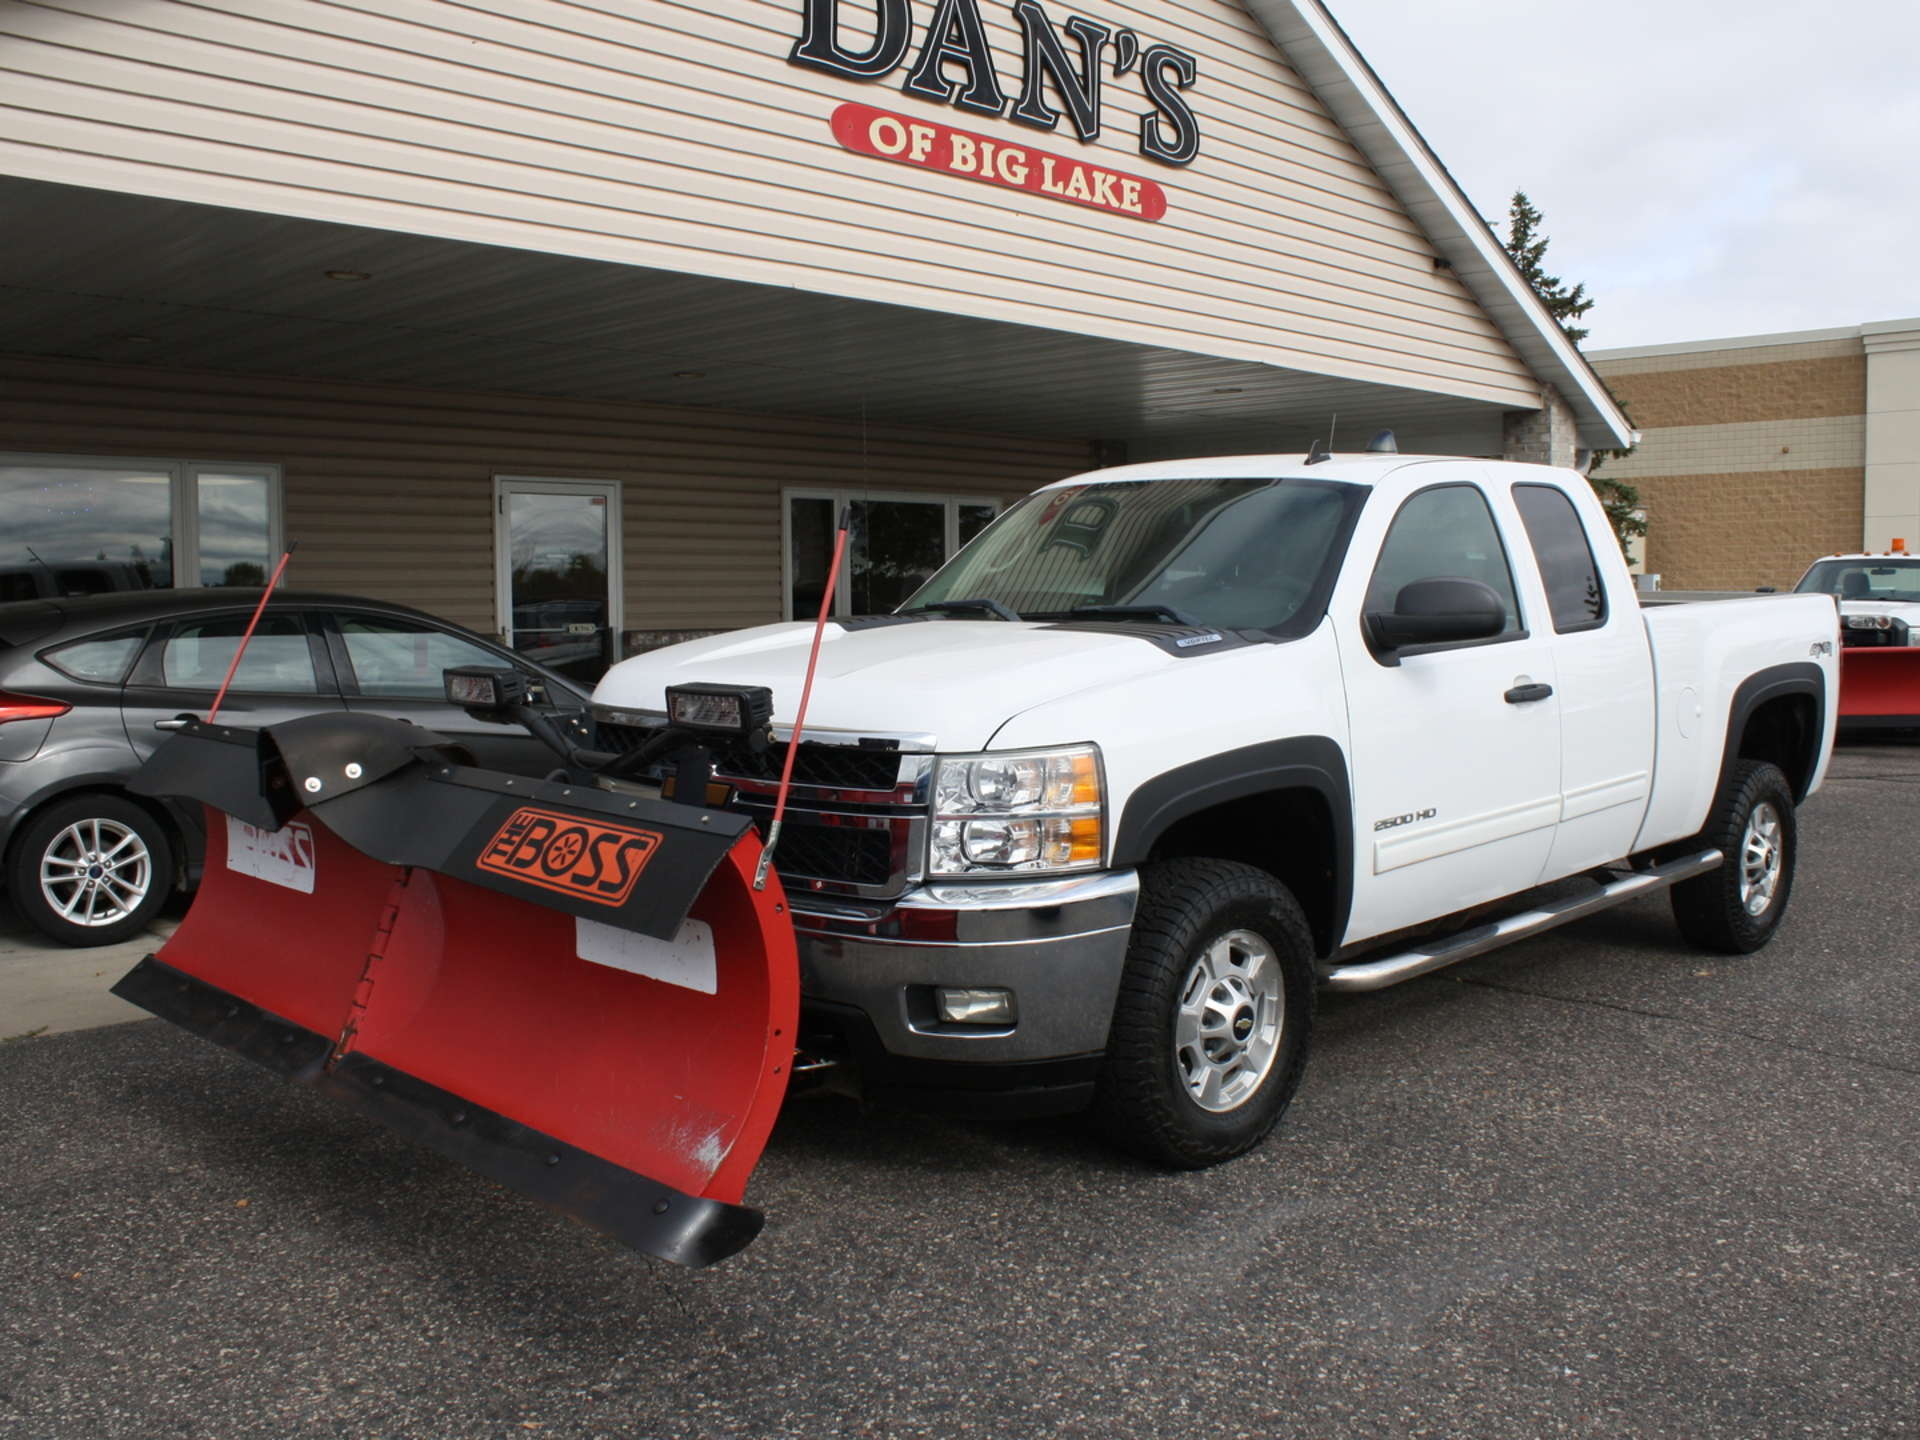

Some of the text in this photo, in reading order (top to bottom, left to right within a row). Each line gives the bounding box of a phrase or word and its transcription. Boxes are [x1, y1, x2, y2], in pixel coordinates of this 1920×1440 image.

[787, 0, 1200, 169] DAN'S
[868, 116, 1143, 214] OF BIG LAKE
[487, 814, 650, 894] THE BOSS
[1374, 808, 1437, 832] 2500 HD
